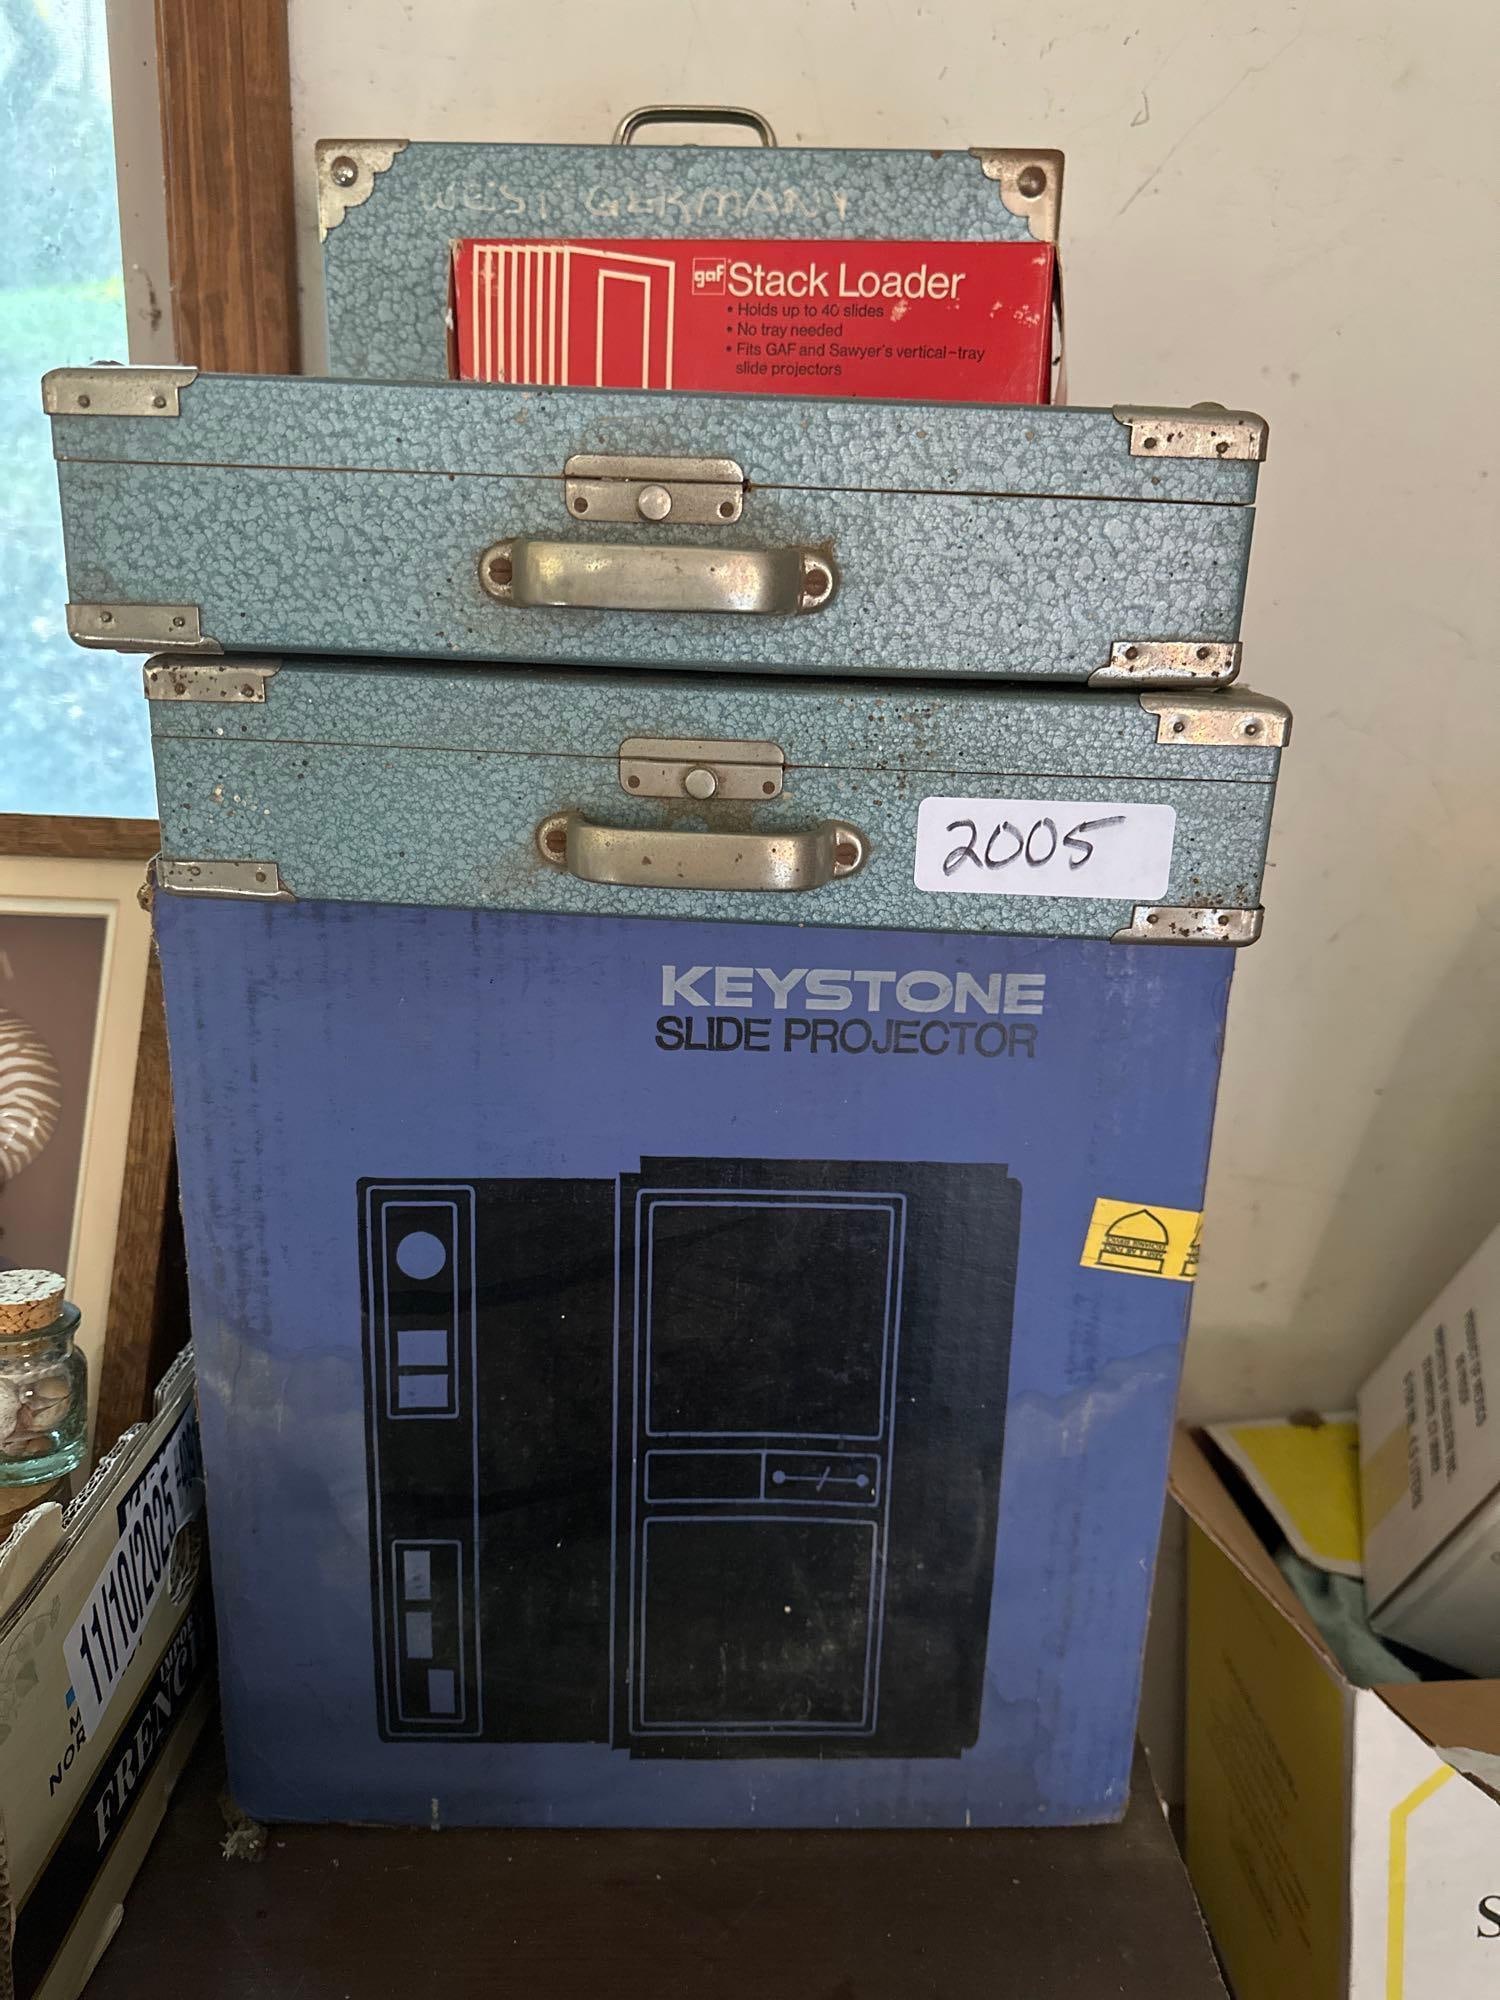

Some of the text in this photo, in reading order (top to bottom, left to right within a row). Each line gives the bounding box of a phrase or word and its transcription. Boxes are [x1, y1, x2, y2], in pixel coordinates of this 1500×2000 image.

[694, 262, 966, 299] gaf Stack Loader
[738, 303, 884, 318] Holds up to 40 slides
[737, 323, 843, 339] No tray needed
[736, 342, 761, 356] Fits
[765, 343, 796, 357] GAF
[800, 343, 825, 357] and
[829, 343, 893, 360] Sawyer's
[736, 361, 842, 377] slide projectors
[943, 816, 1126, 876] 2005
[661, 965, 1046, 1015] KEYSTONE
[655, 1015, 1039, 1058] SLIDE PROJECTOR
[80, 1466, 177, 1704] 11/10/2025
